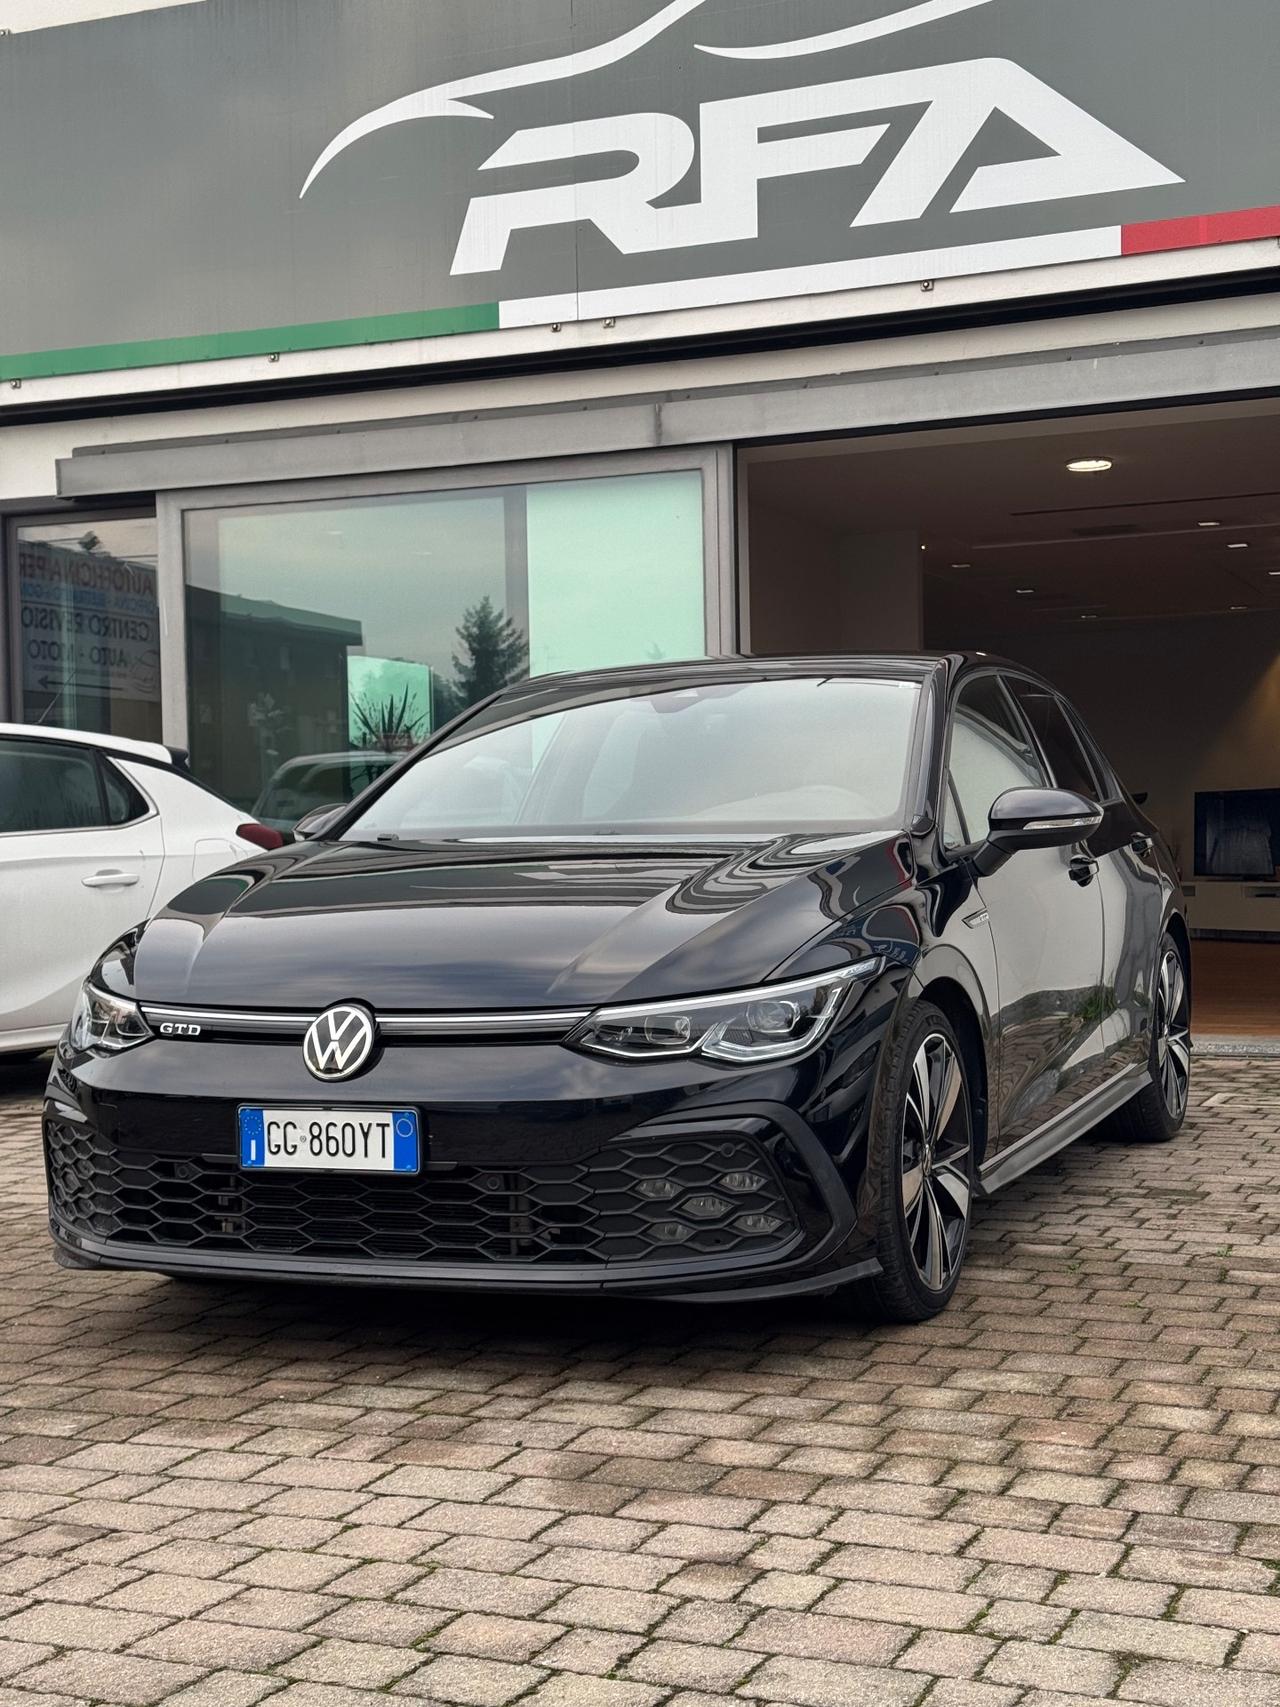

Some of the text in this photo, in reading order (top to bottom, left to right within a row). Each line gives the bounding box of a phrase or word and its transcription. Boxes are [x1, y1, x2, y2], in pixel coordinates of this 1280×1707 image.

[449, 57, 1186, 275] RFA
[159, 1022, 201, 1036] GTD
[266, 1121, 297, 1156] GG
[309, 1121, 390, 1158] 860YT
